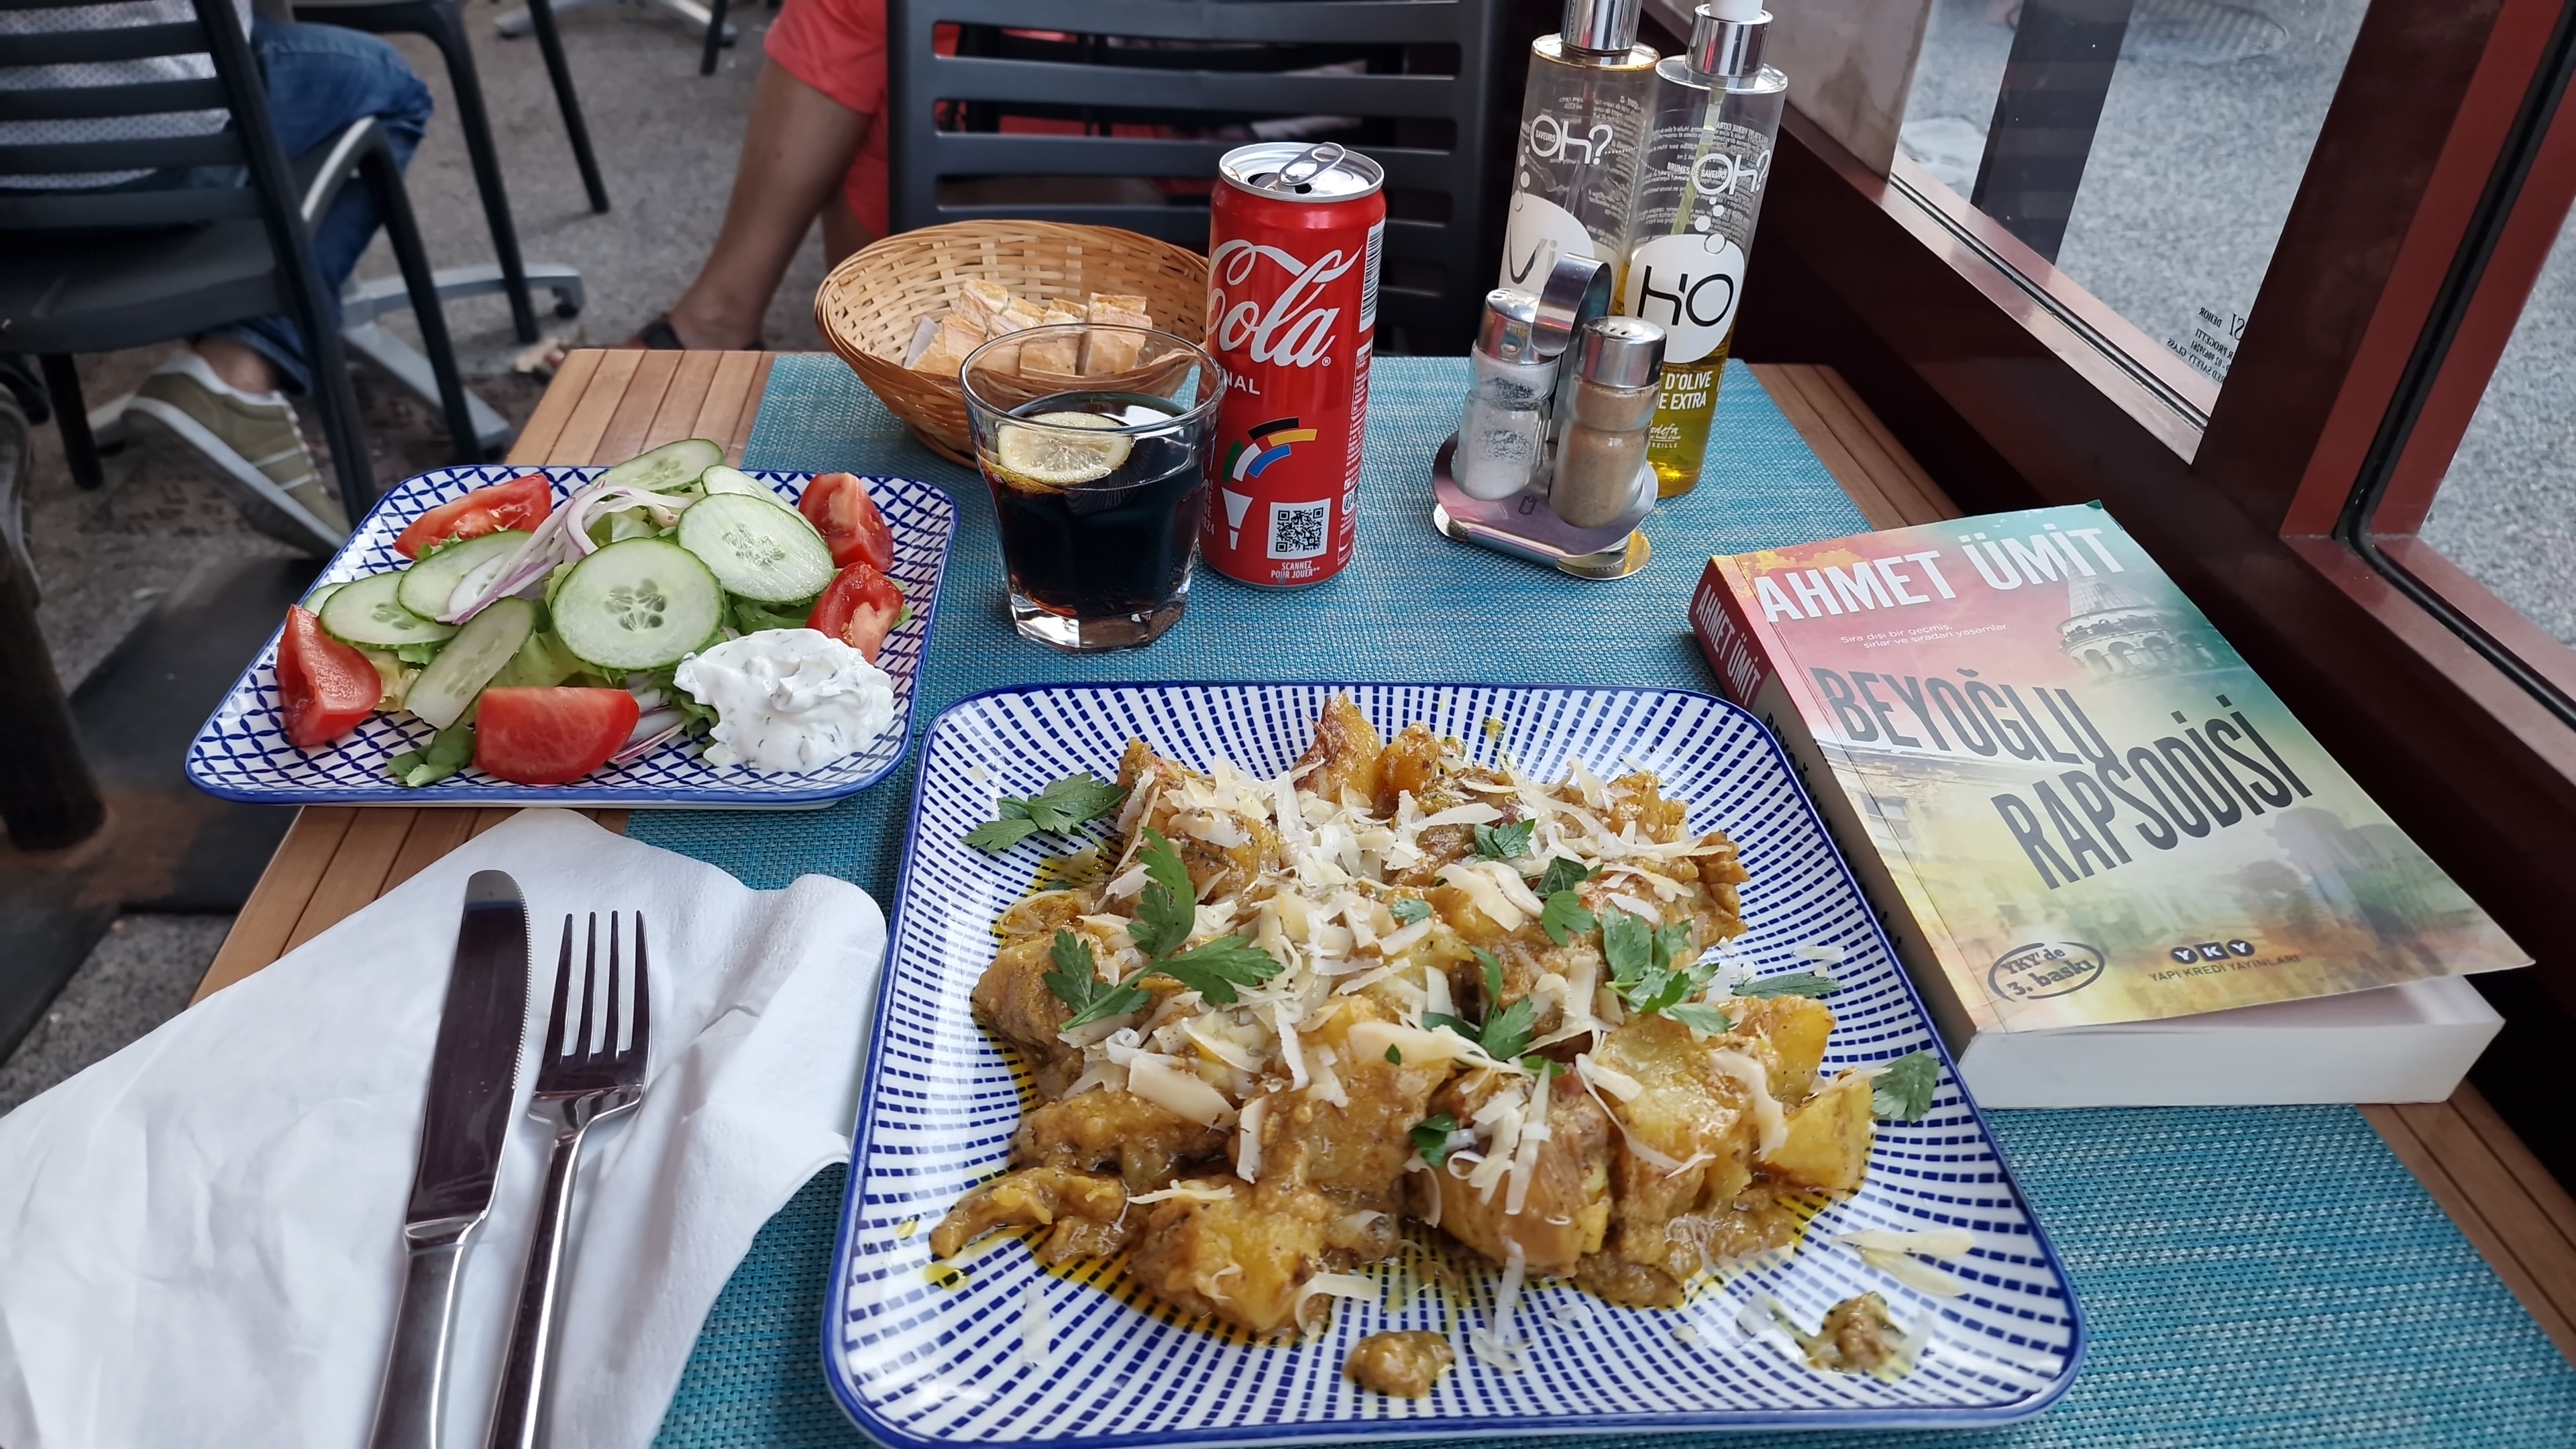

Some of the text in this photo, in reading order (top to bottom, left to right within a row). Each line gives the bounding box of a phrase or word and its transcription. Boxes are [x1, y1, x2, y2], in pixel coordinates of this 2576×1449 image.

[1535, 129, 1556, 143] SAVEURS
[1667, 162, 1727, 179] BRUMES DE SAVEURS
[1664, 370, 1713, 390] D'OLIVE
[1670, 390, 1707, 410] EXTRA
[1650, 423, 1678, 438] odefa
[1271, 570, 1289, 578] POUR
[1281, 560, 1312, 571] SCANNEZ
[1752, 523, 2125, 623] AHMET ÜMİT
[1840, 635, 1864, 644] Sıra
[1888, 629, 1904, 637] bir
[1908, 623, 1953, 636] geçmiş,
[1863, 623, 2008, 649] sırlar ve sıradan yaşamlar
[1695, 584, 1763, 705] AHMET ÜMİT
[1809, 667, 2119, 766] BEYOĞLU
[1990, 694, 2313, 891] RAPSODİSİ
[2000, 946, 2065, 975] YKY'de
[2171, 941, 2249, 961] YKY
[2006, 959, 2096, 996] 3. baskı
[2147, 955, 2300, 982] YAPI KREDİ YAYINLARI
